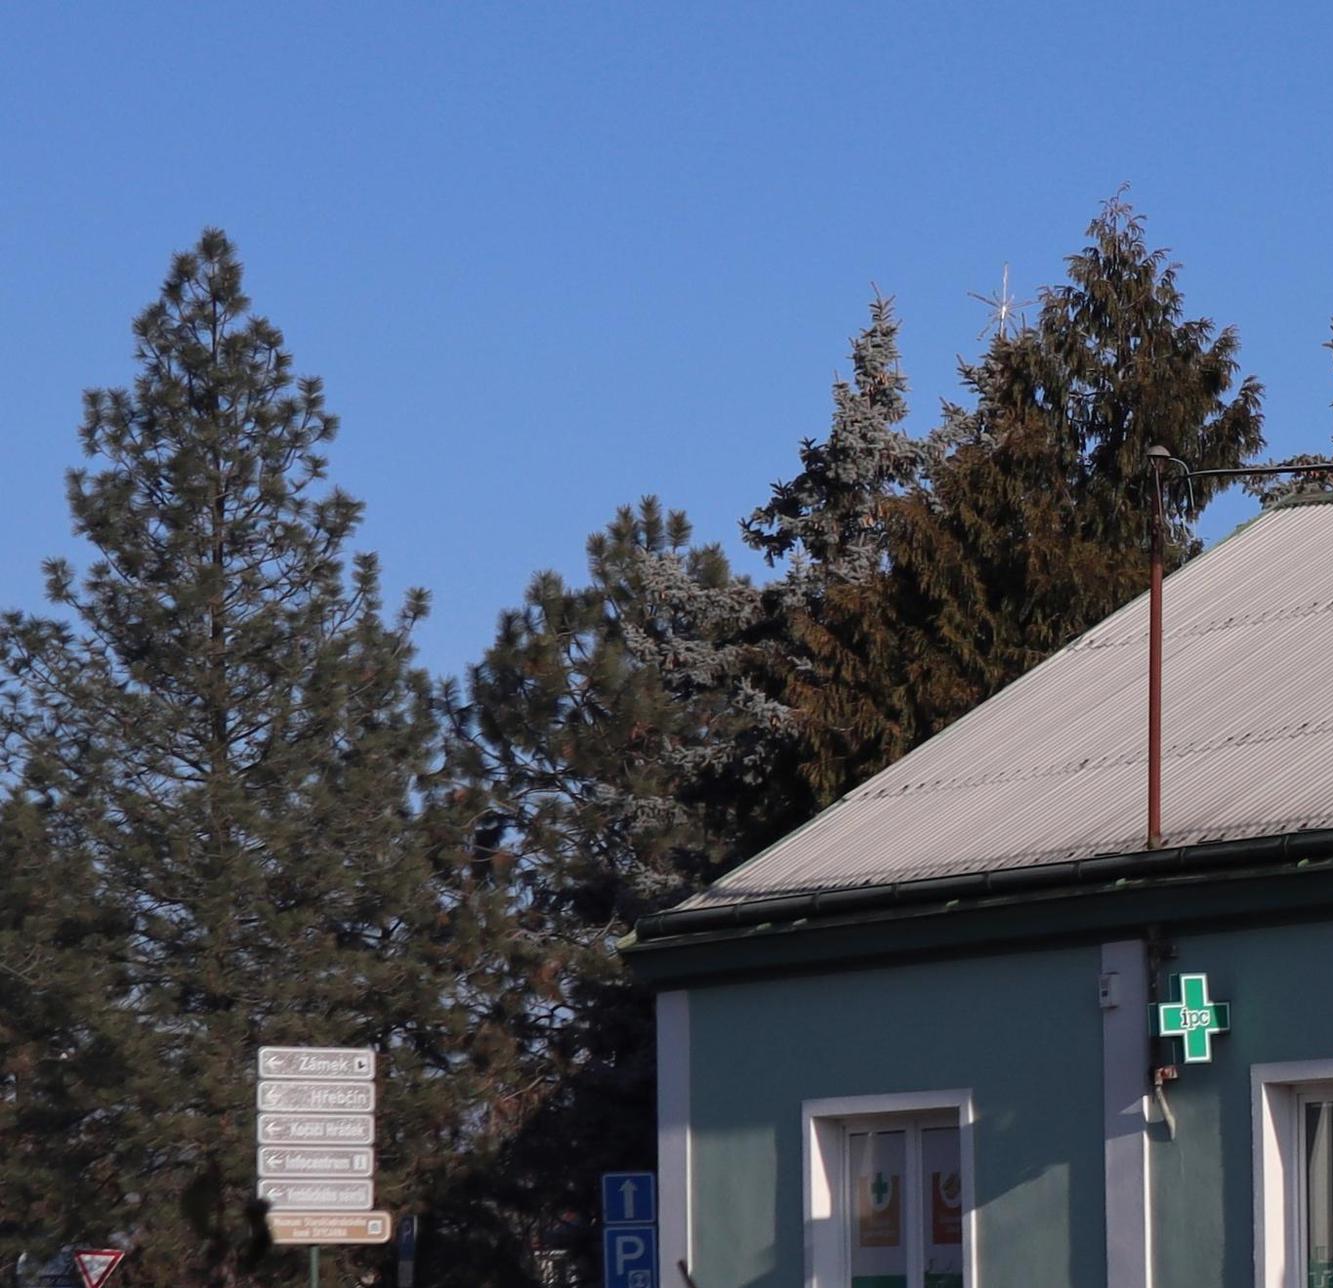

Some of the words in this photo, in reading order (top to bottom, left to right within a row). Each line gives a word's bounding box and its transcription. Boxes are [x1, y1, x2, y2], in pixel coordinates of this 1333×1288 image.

[1179, 1006, 1210, 1031] ipc
[297, 1055, 349, 1072] Zámek
[616, 1236, 645, 1275] P
